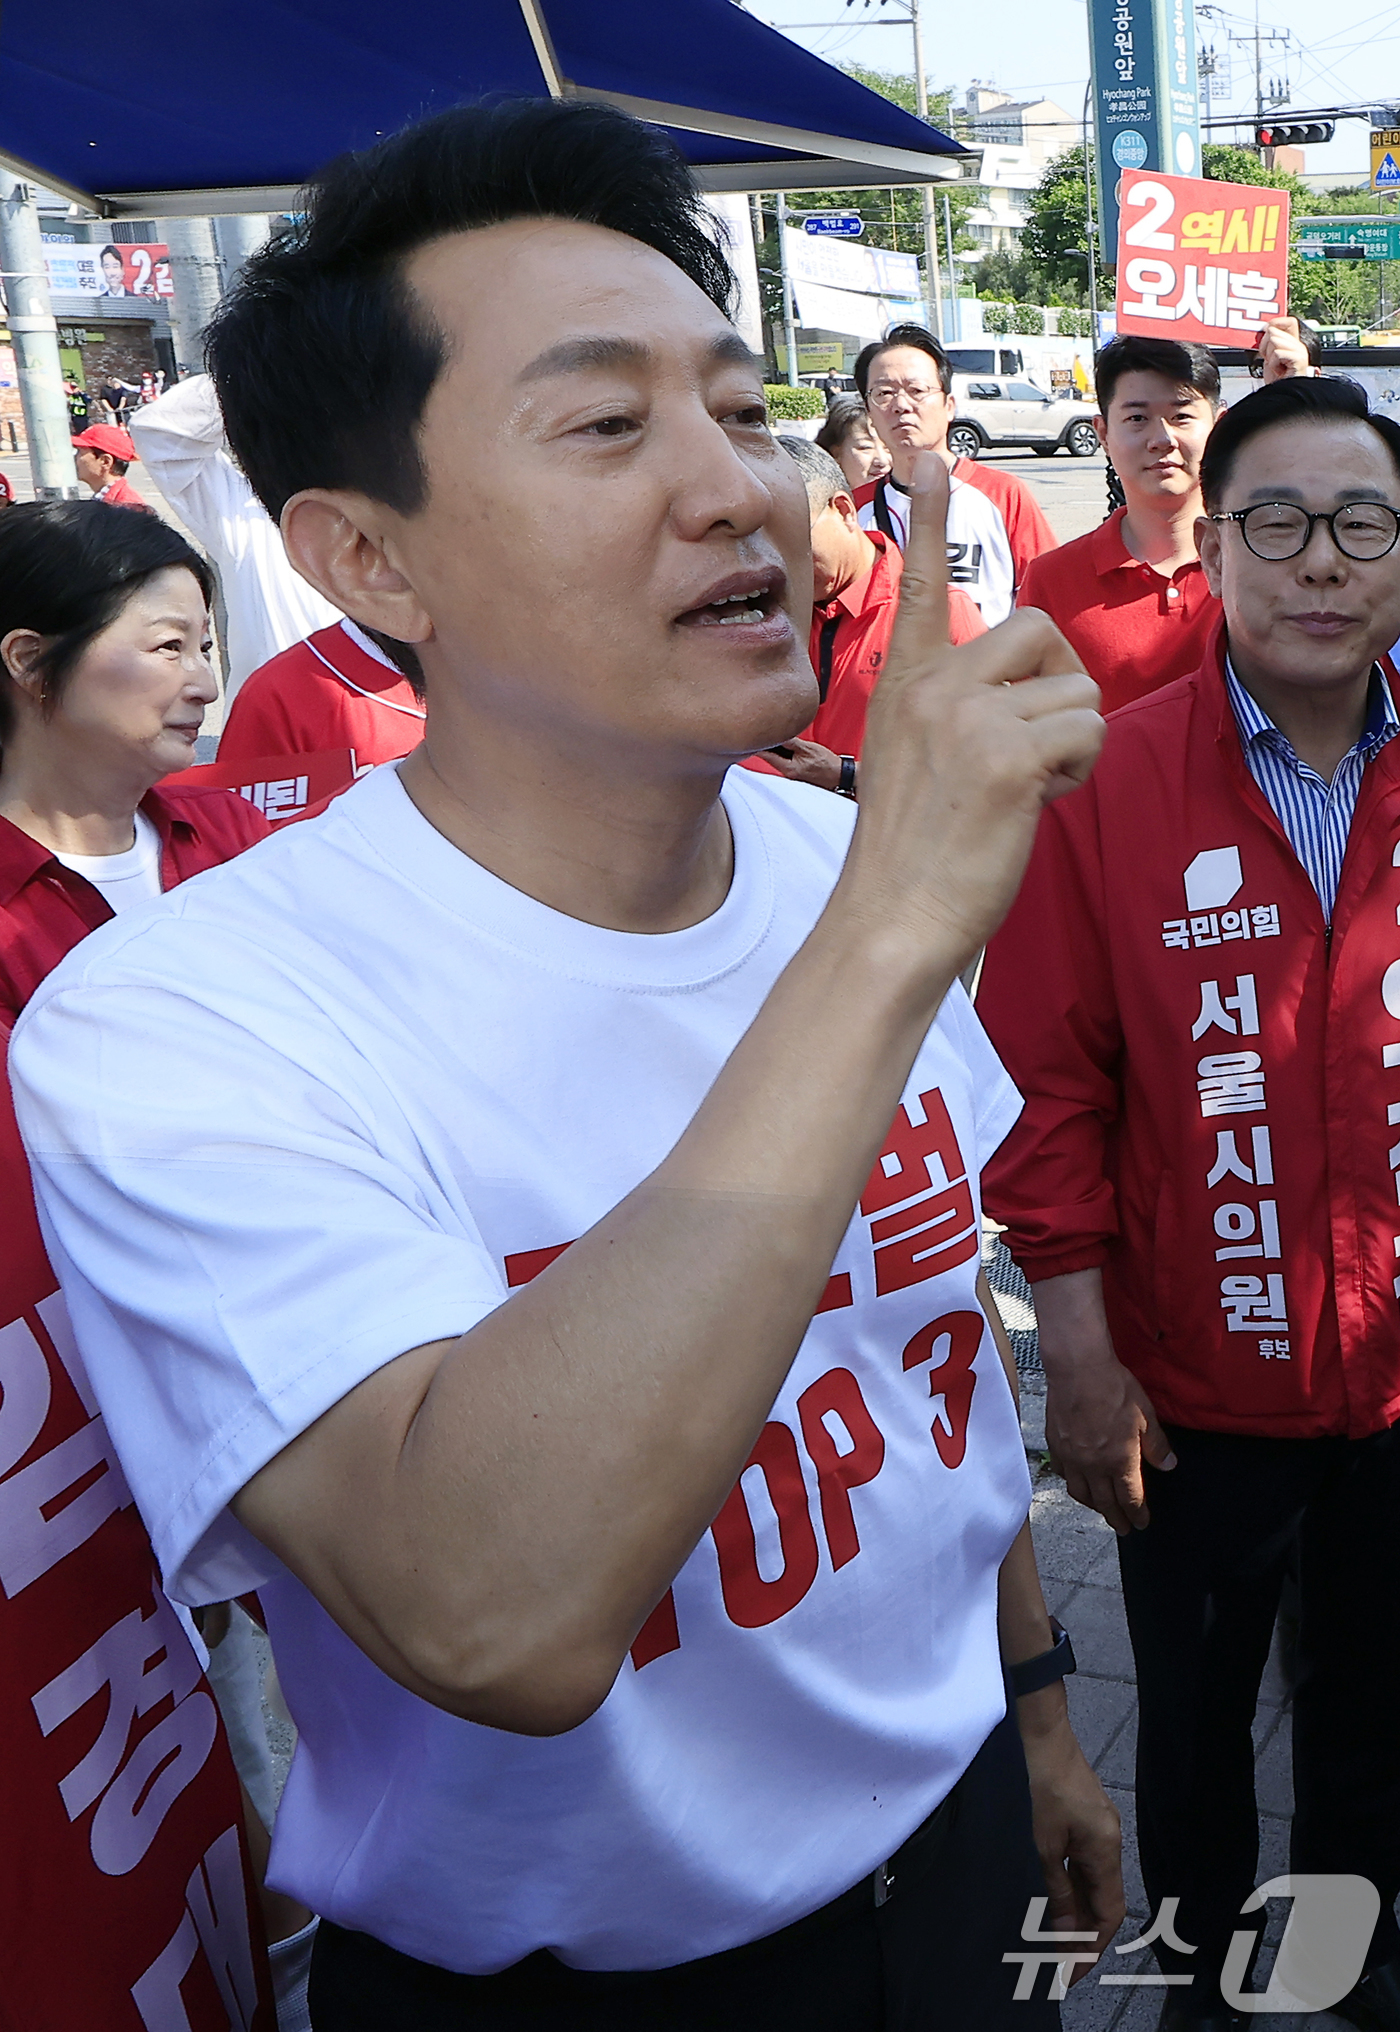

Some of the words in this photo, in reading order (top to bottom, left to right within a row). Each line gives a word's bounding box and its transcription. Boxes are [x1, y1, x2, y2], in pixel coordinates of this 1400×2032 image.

[1102, 88, 1136, 101] Hyochang
[1136, 86, 1151, 98] Park
[1116, 147, 1145, 161] 경의중앙
[1120, 136, 1140, 147] K311
[1125, 180, 1176, 252] 2
[1180, 204, 1281, 255] 역시!
[1122, 257, 1280, 332] 오세훈
[57, 327, 88, 347] 병원
[1161, 903, 1280, 951] 국민의힘
[1191, 972, 1290, 1334] 서울시의원
[1257, 1337, 1291, 1361] 후보
[903, 1309, 985, 1470] 3
